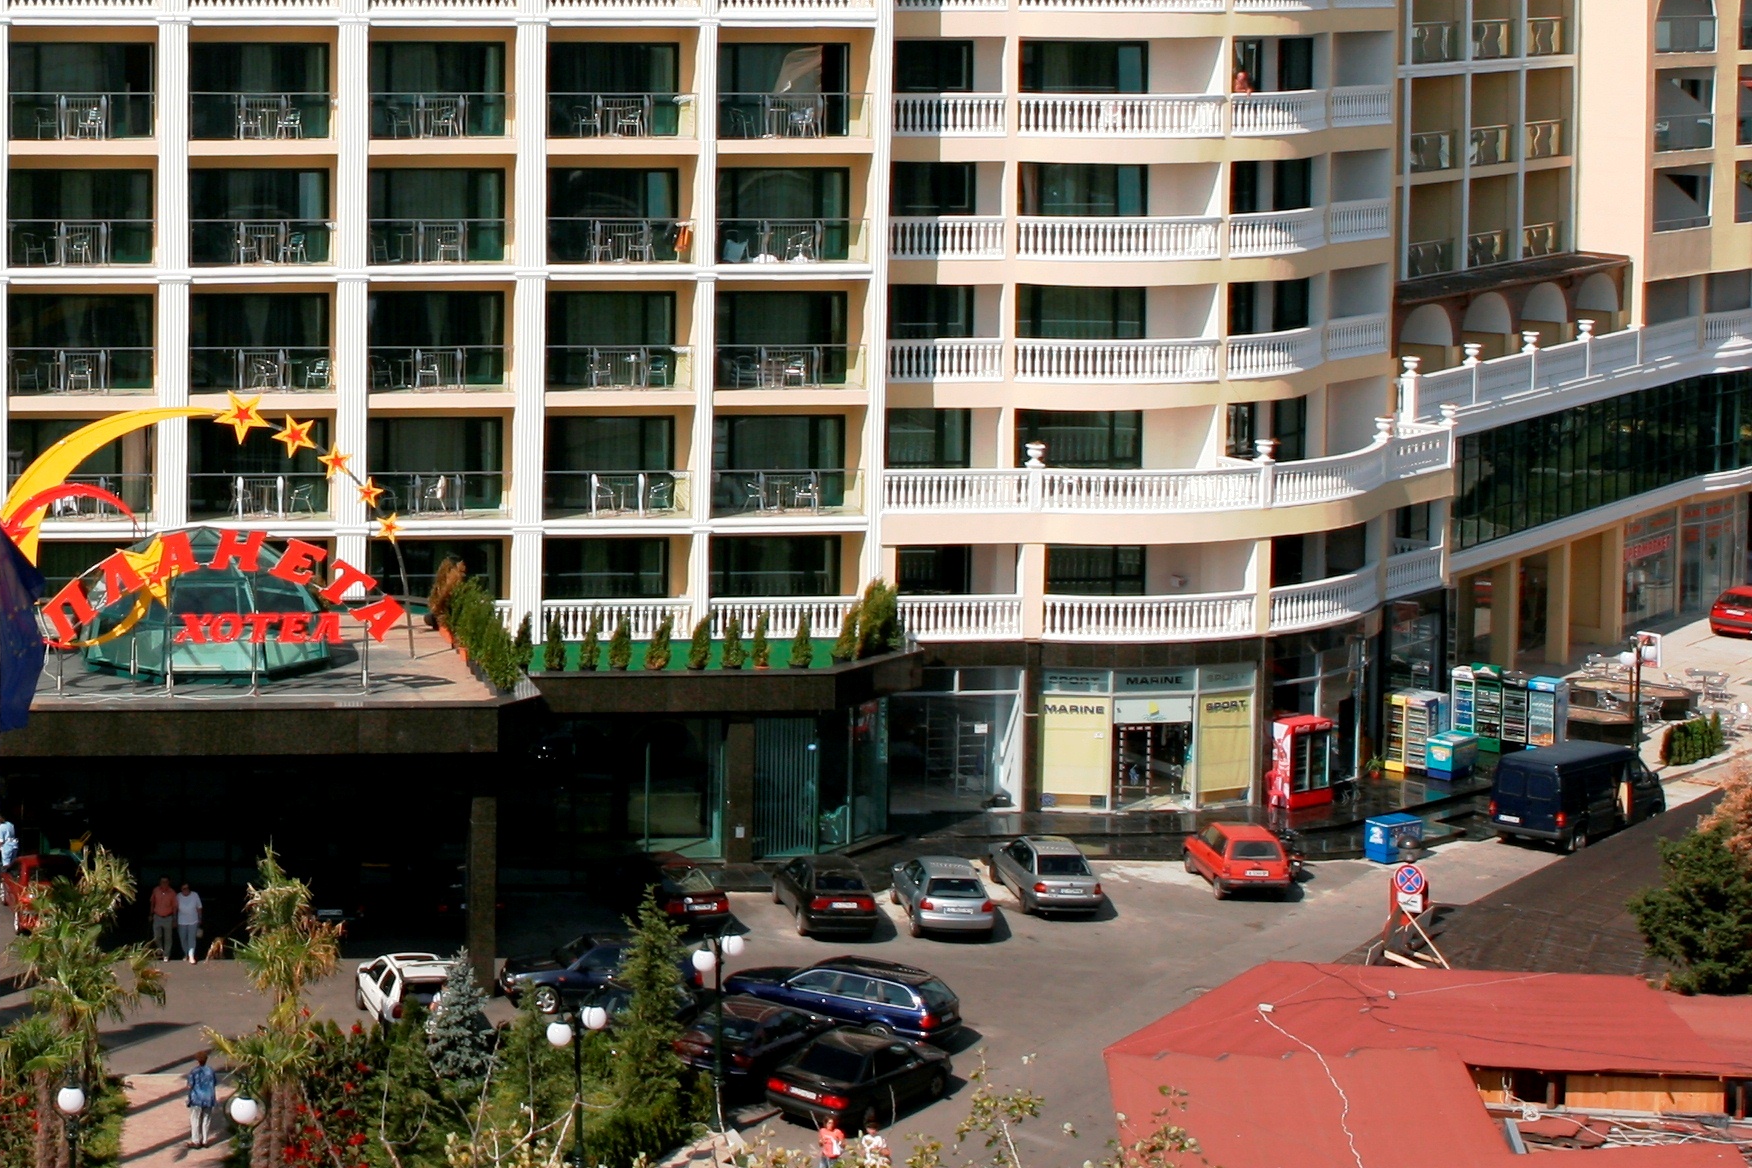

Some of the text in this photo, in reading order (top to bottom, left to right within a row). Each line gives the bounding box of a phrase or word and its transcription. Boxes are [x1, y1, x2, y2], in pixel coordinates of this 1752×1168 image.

[43, 530, 405, 643] ПЛАНЕТА
[174, 611, 343, 644] ХОТЕЛ
[1126, 676, 1182, 686] MARINE
[1044, 699, 1247, 715] MARINE SPORT
